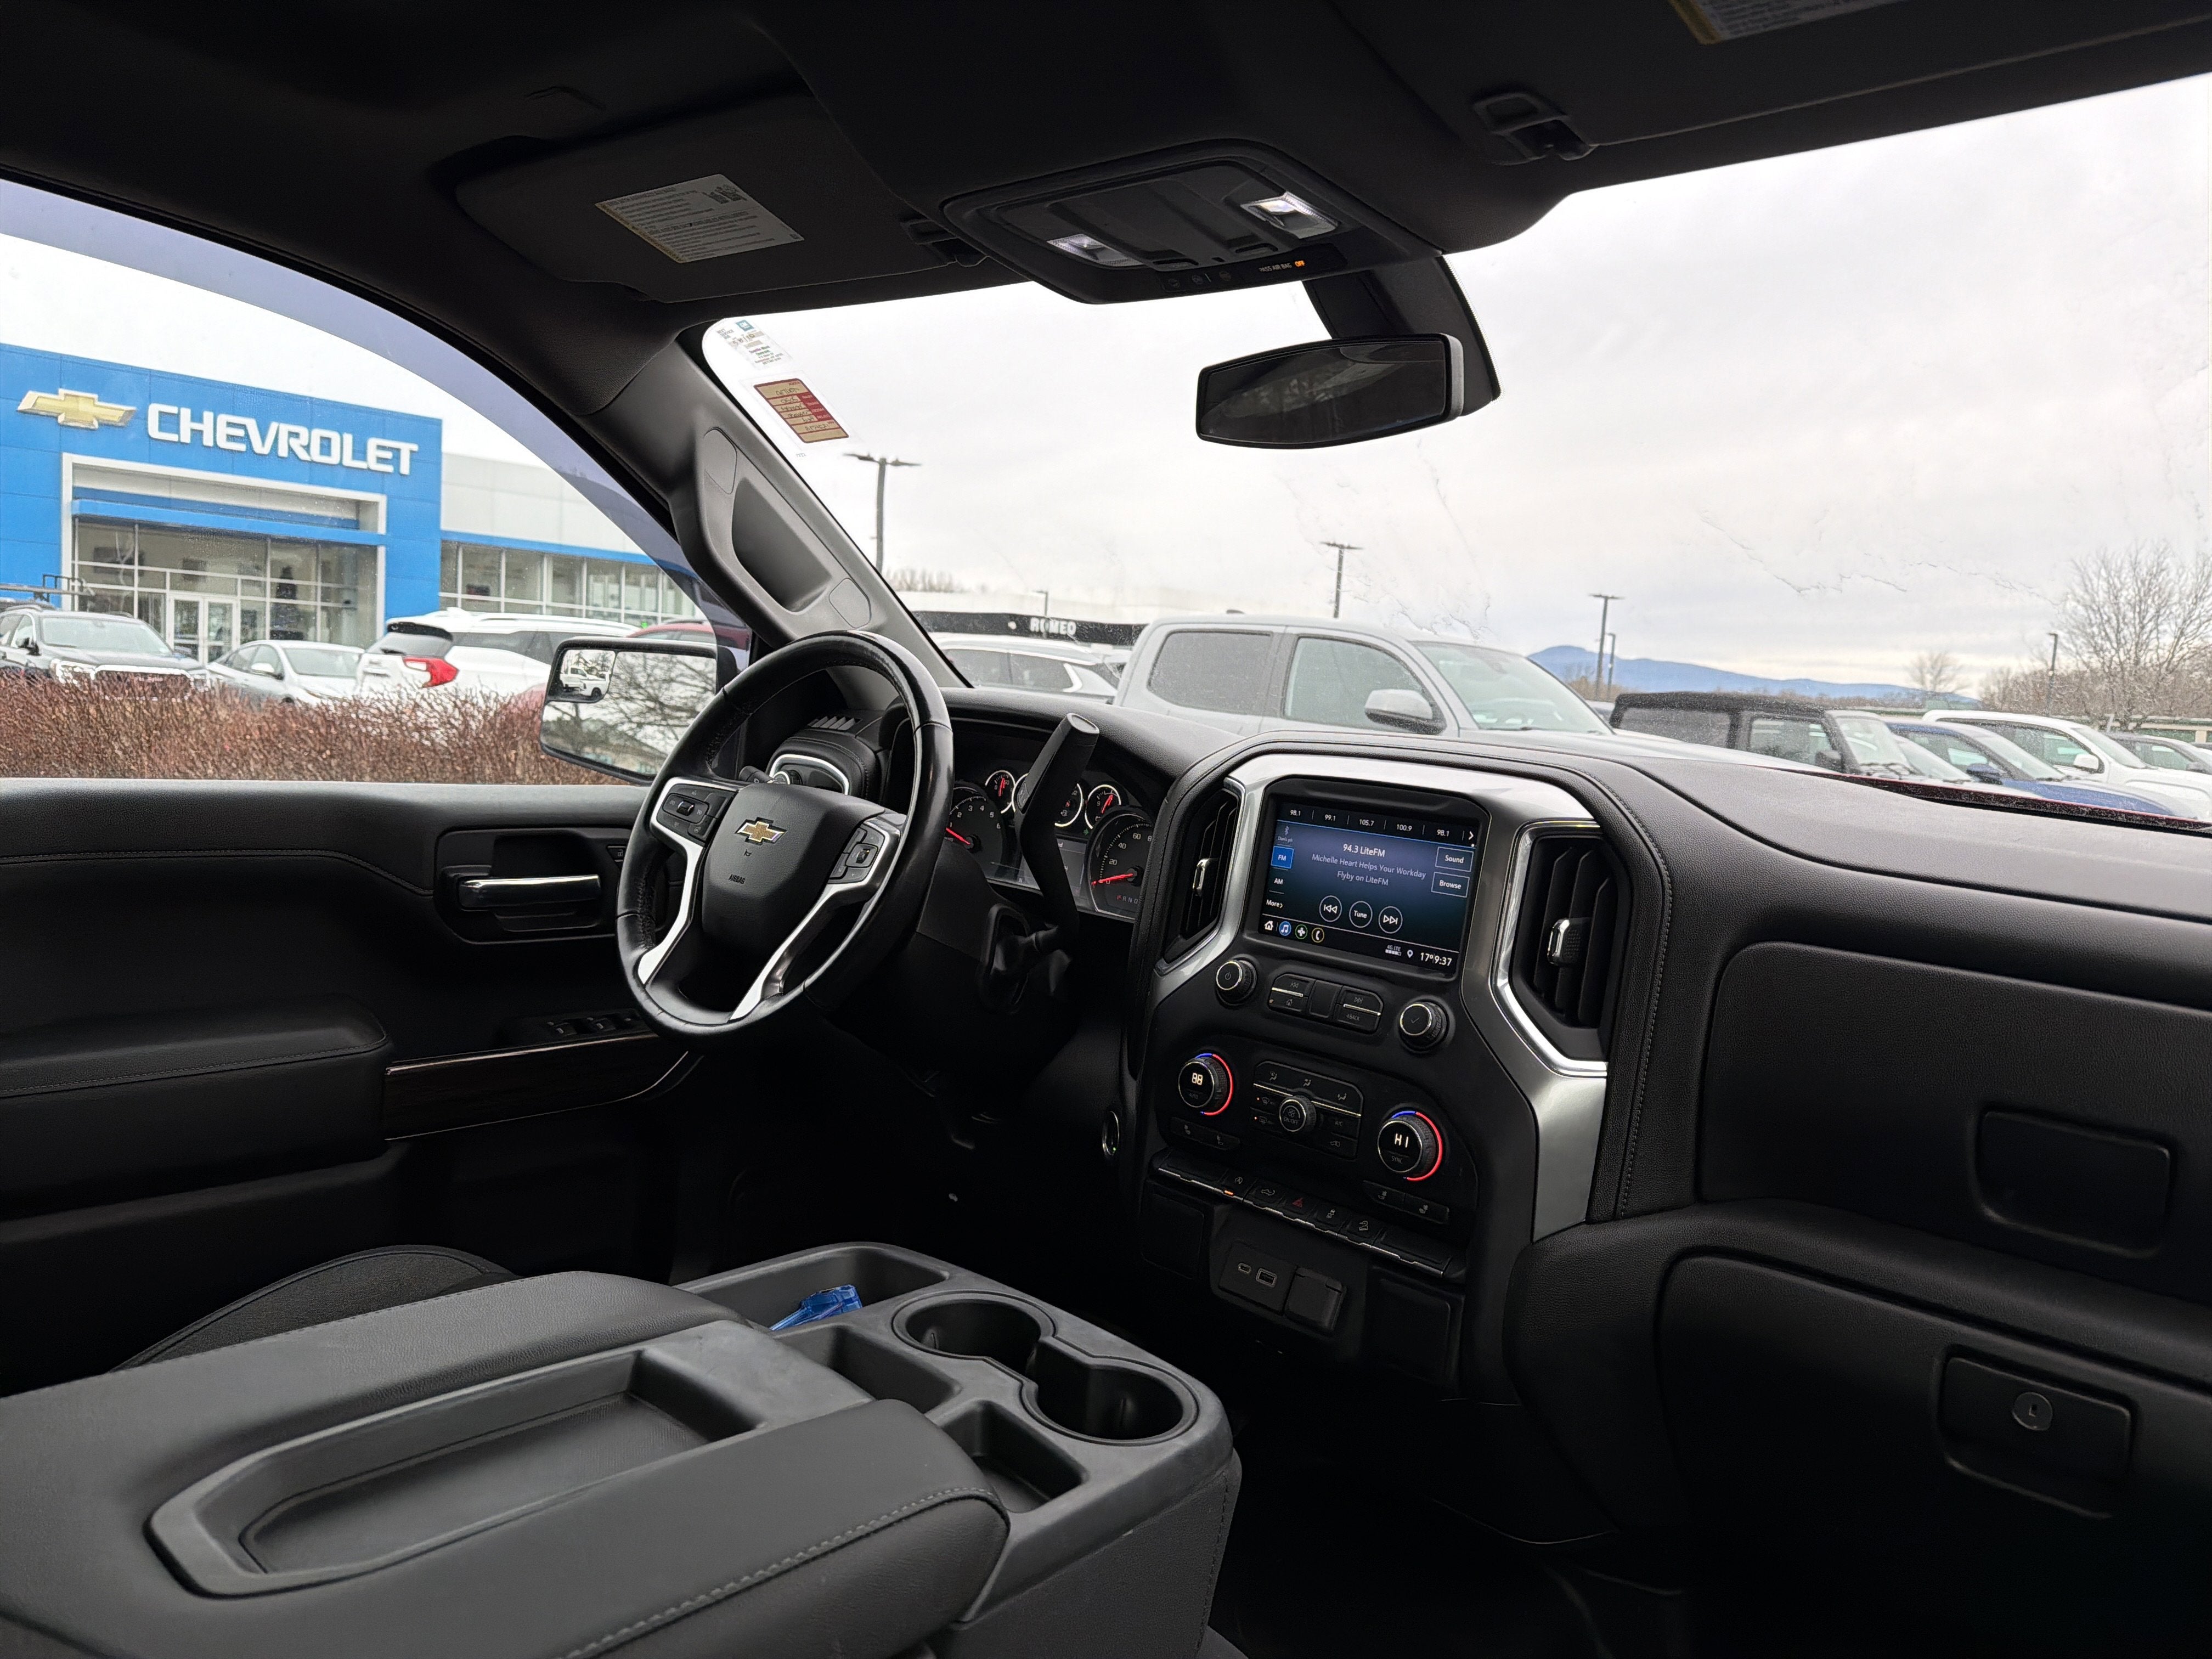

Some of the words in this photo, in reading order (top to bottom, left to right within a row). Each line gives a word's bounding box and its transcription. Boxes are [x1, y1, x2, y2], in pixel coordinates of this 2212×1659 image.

[148, 403, 419, 475] CHEVROLET
[1359, 819, 1374, 827] 105.7
[1396, 823, 1412, 832] 100.9
[1437, 828, 1449, 837] 98.1
[1343, 843, 1358, 854] 94.3
[1359, 845, 1386, 857] LiteFM
[1445, 854, 1464, 864] Sound
[1312, 853, 1338, 865] Michelle
[1339, 858, 1358, 867] Heart
[1358, 861, 1378, 872] Helps
[1379, 865, 1395, 873] Your
[1396, 867, 1426, 880] Workday
[729, 874, 746, 884] AIRBAG
[1274, 877, 1283, 885] AM
[1337, 871, 1355, 882] Flyby
[1365, 876, 1389, 885] LiteFM
[1439, 879, 1462, 890] Browse
[1266, 899, 1279, 909] More
[1354, 910, 1367, 919] Tune
[1434, 956, 1452, 967] 9:37
[1191, 1072, 1204, 1086] 88
[1283, 1116, 1299, 1125] ON/OFF
[1391, 1155, 1403, 1164] SYNC
